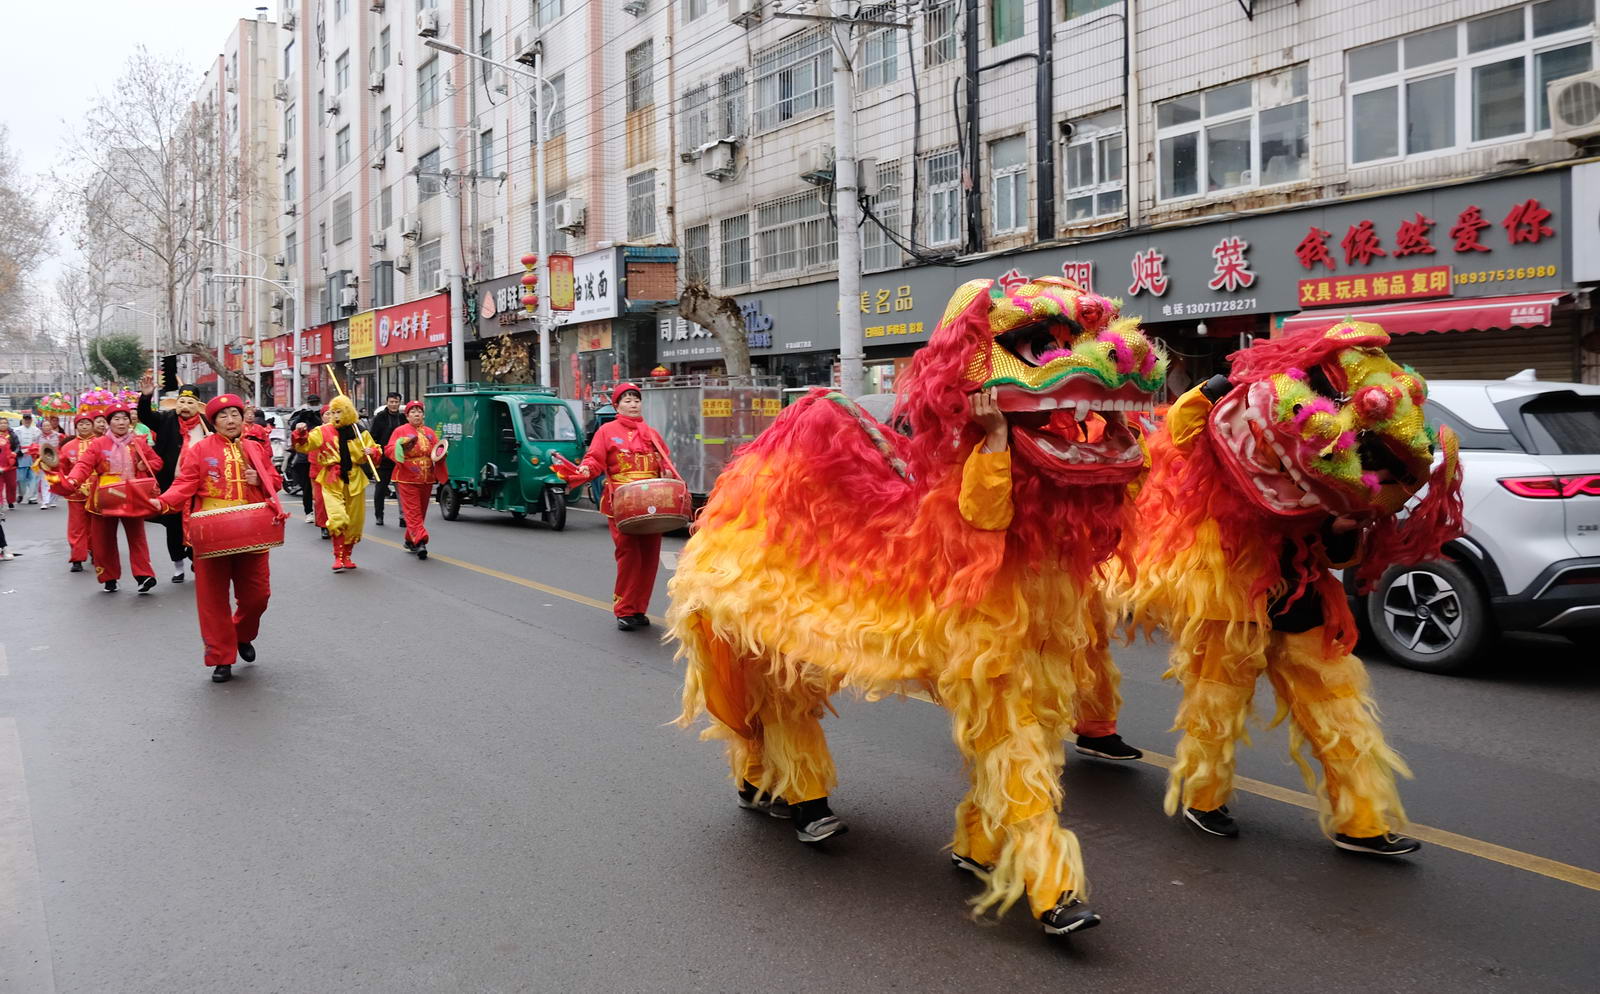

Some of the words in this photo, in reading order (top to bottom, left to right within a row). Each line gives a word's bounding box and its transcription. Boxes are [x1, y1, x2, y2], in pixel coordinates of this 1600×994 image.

[1294, 198, 1555, 270] 我依然爱你
[1301, 282, 1332, 303] 文具
[1335, 279, 1368, 300] 玩具
[1372, 275, 1406, 296] 饰品
[1411, 271, 1447, 294] 复印
[1453, 265, 1557, 286] 18937536980
[1163, 303, 1184, 316] 电话
[1186, 298, 1257, 315] 13071728271
